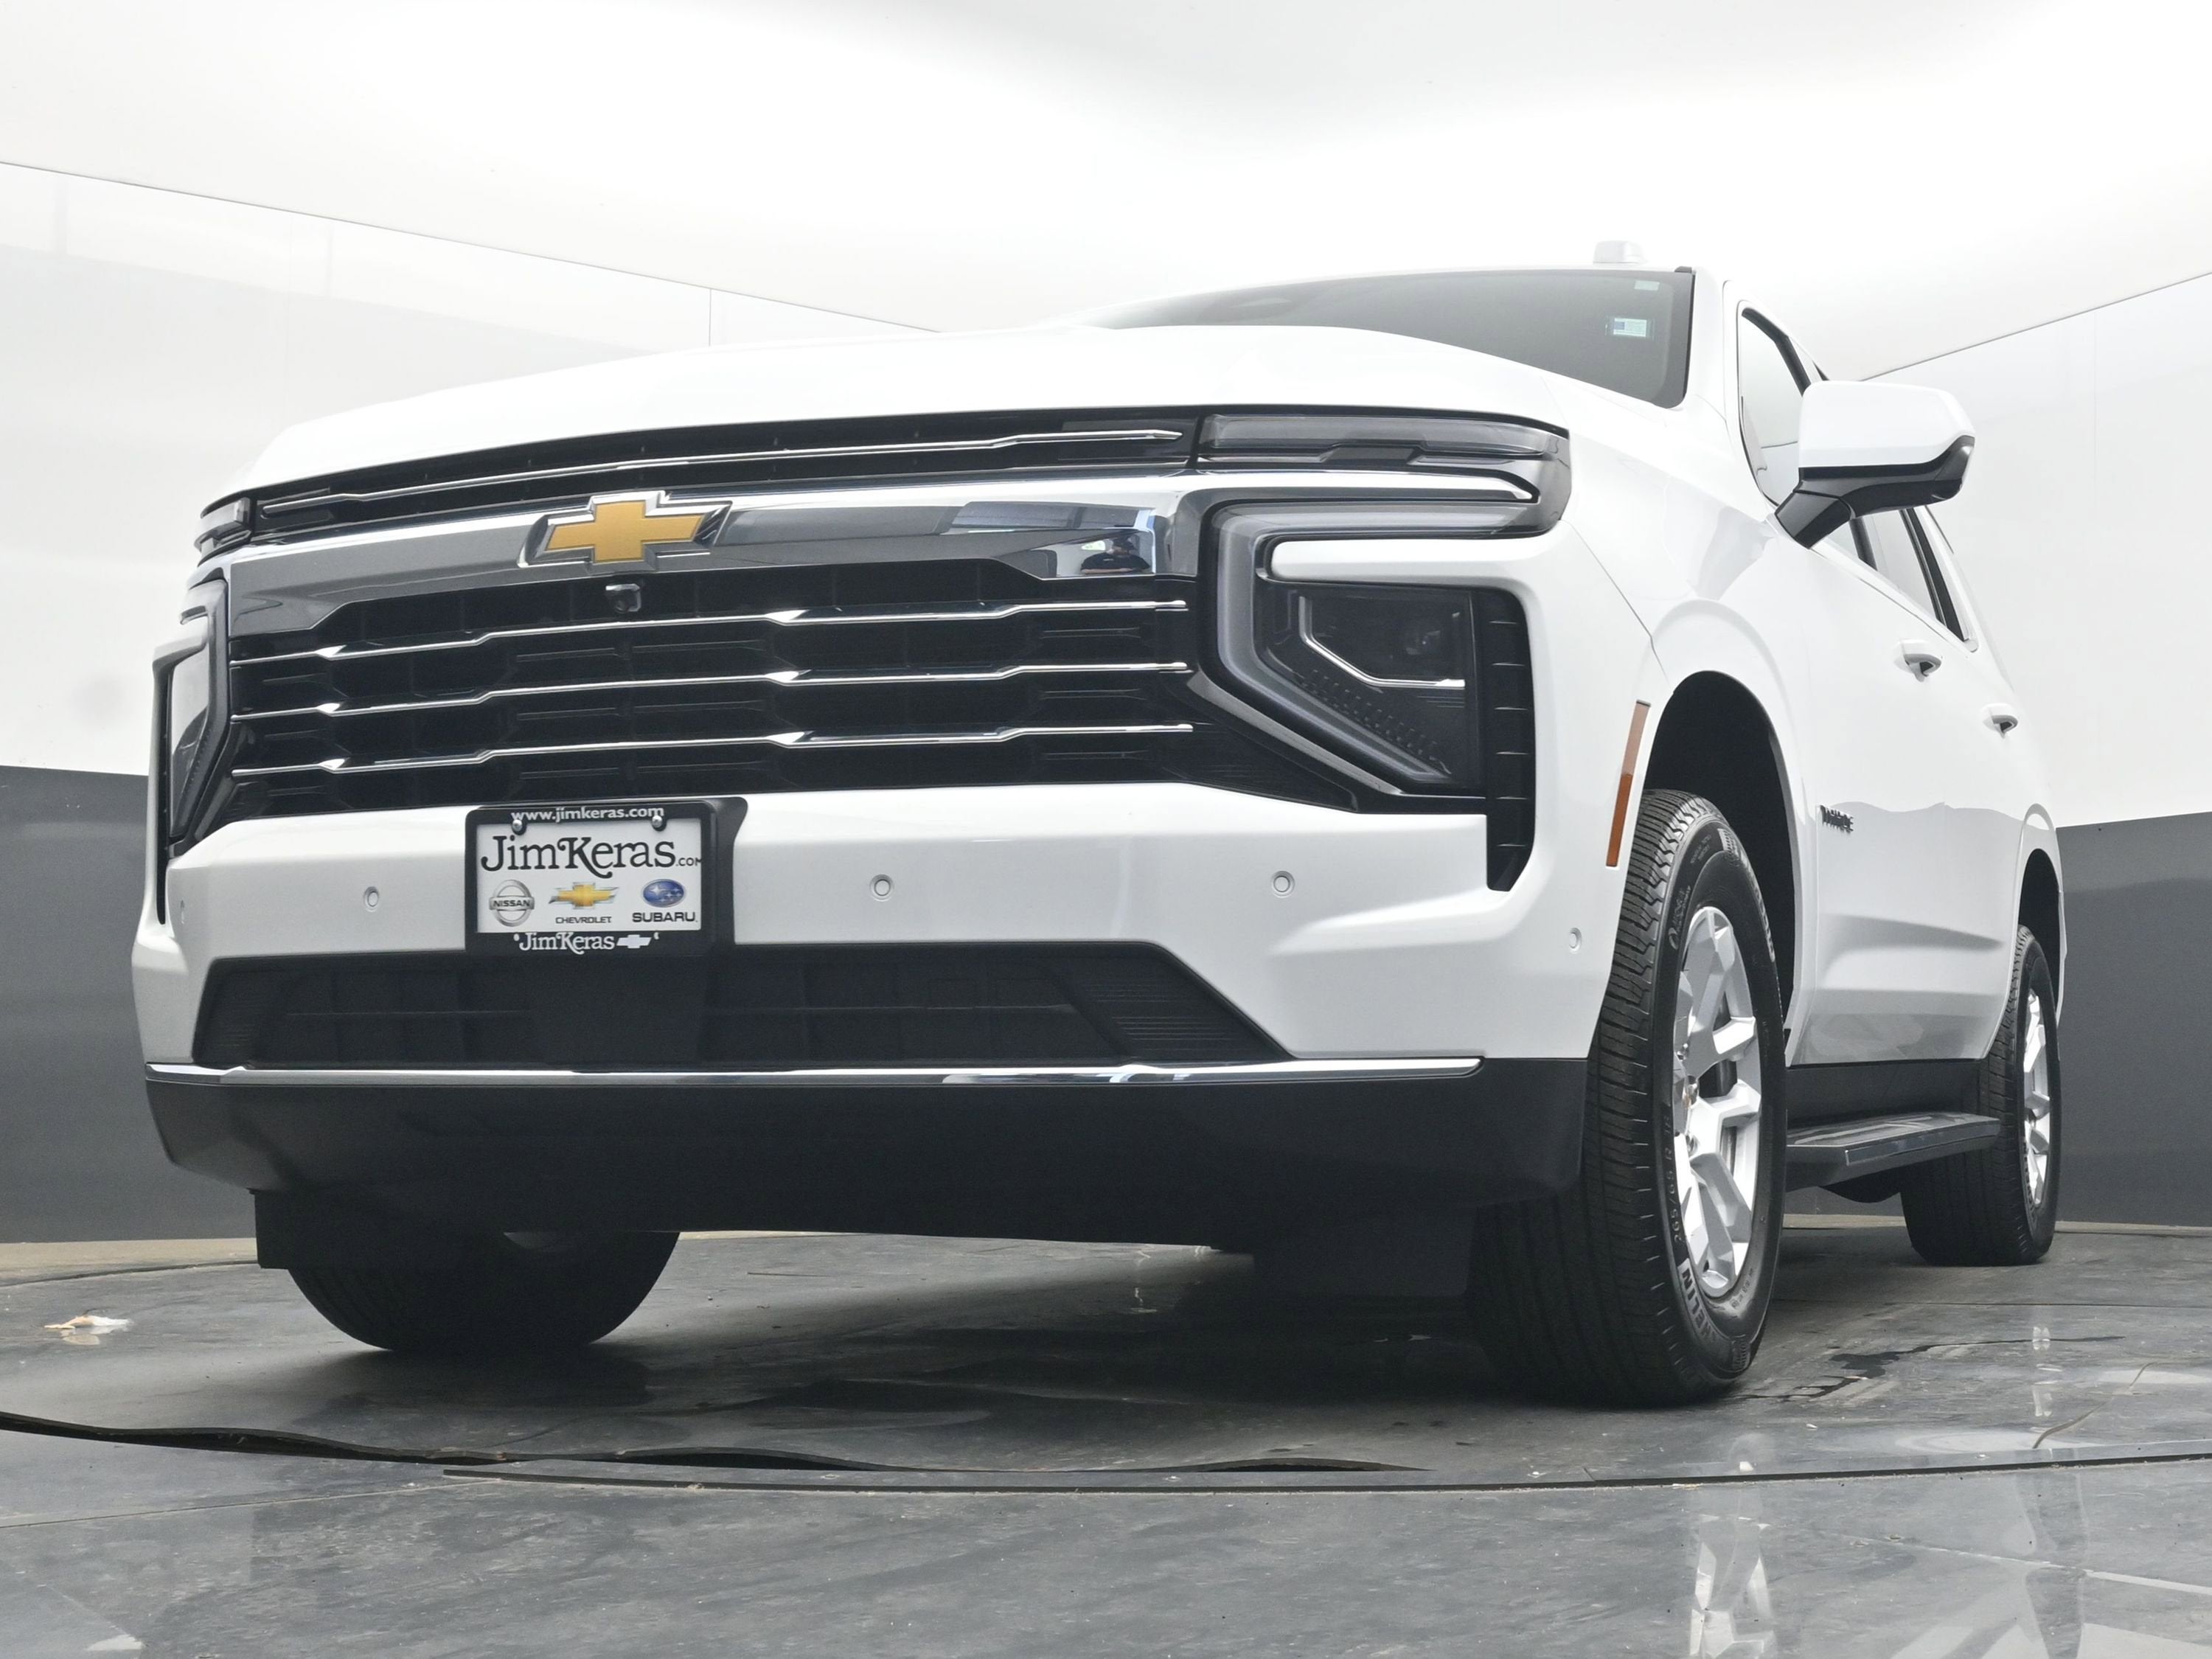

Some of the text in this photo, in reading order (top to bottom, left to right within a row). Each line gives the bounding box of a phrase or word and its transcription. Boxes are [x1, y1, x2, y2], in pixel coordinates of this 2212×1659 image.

[511, 807, 664, 823] www.jimkeras.com
[555, 916, 612, 924] CHEVROLET
[632, 911, 695, 922] SUBARU
[518, 931, 615, 955] JimKeras
